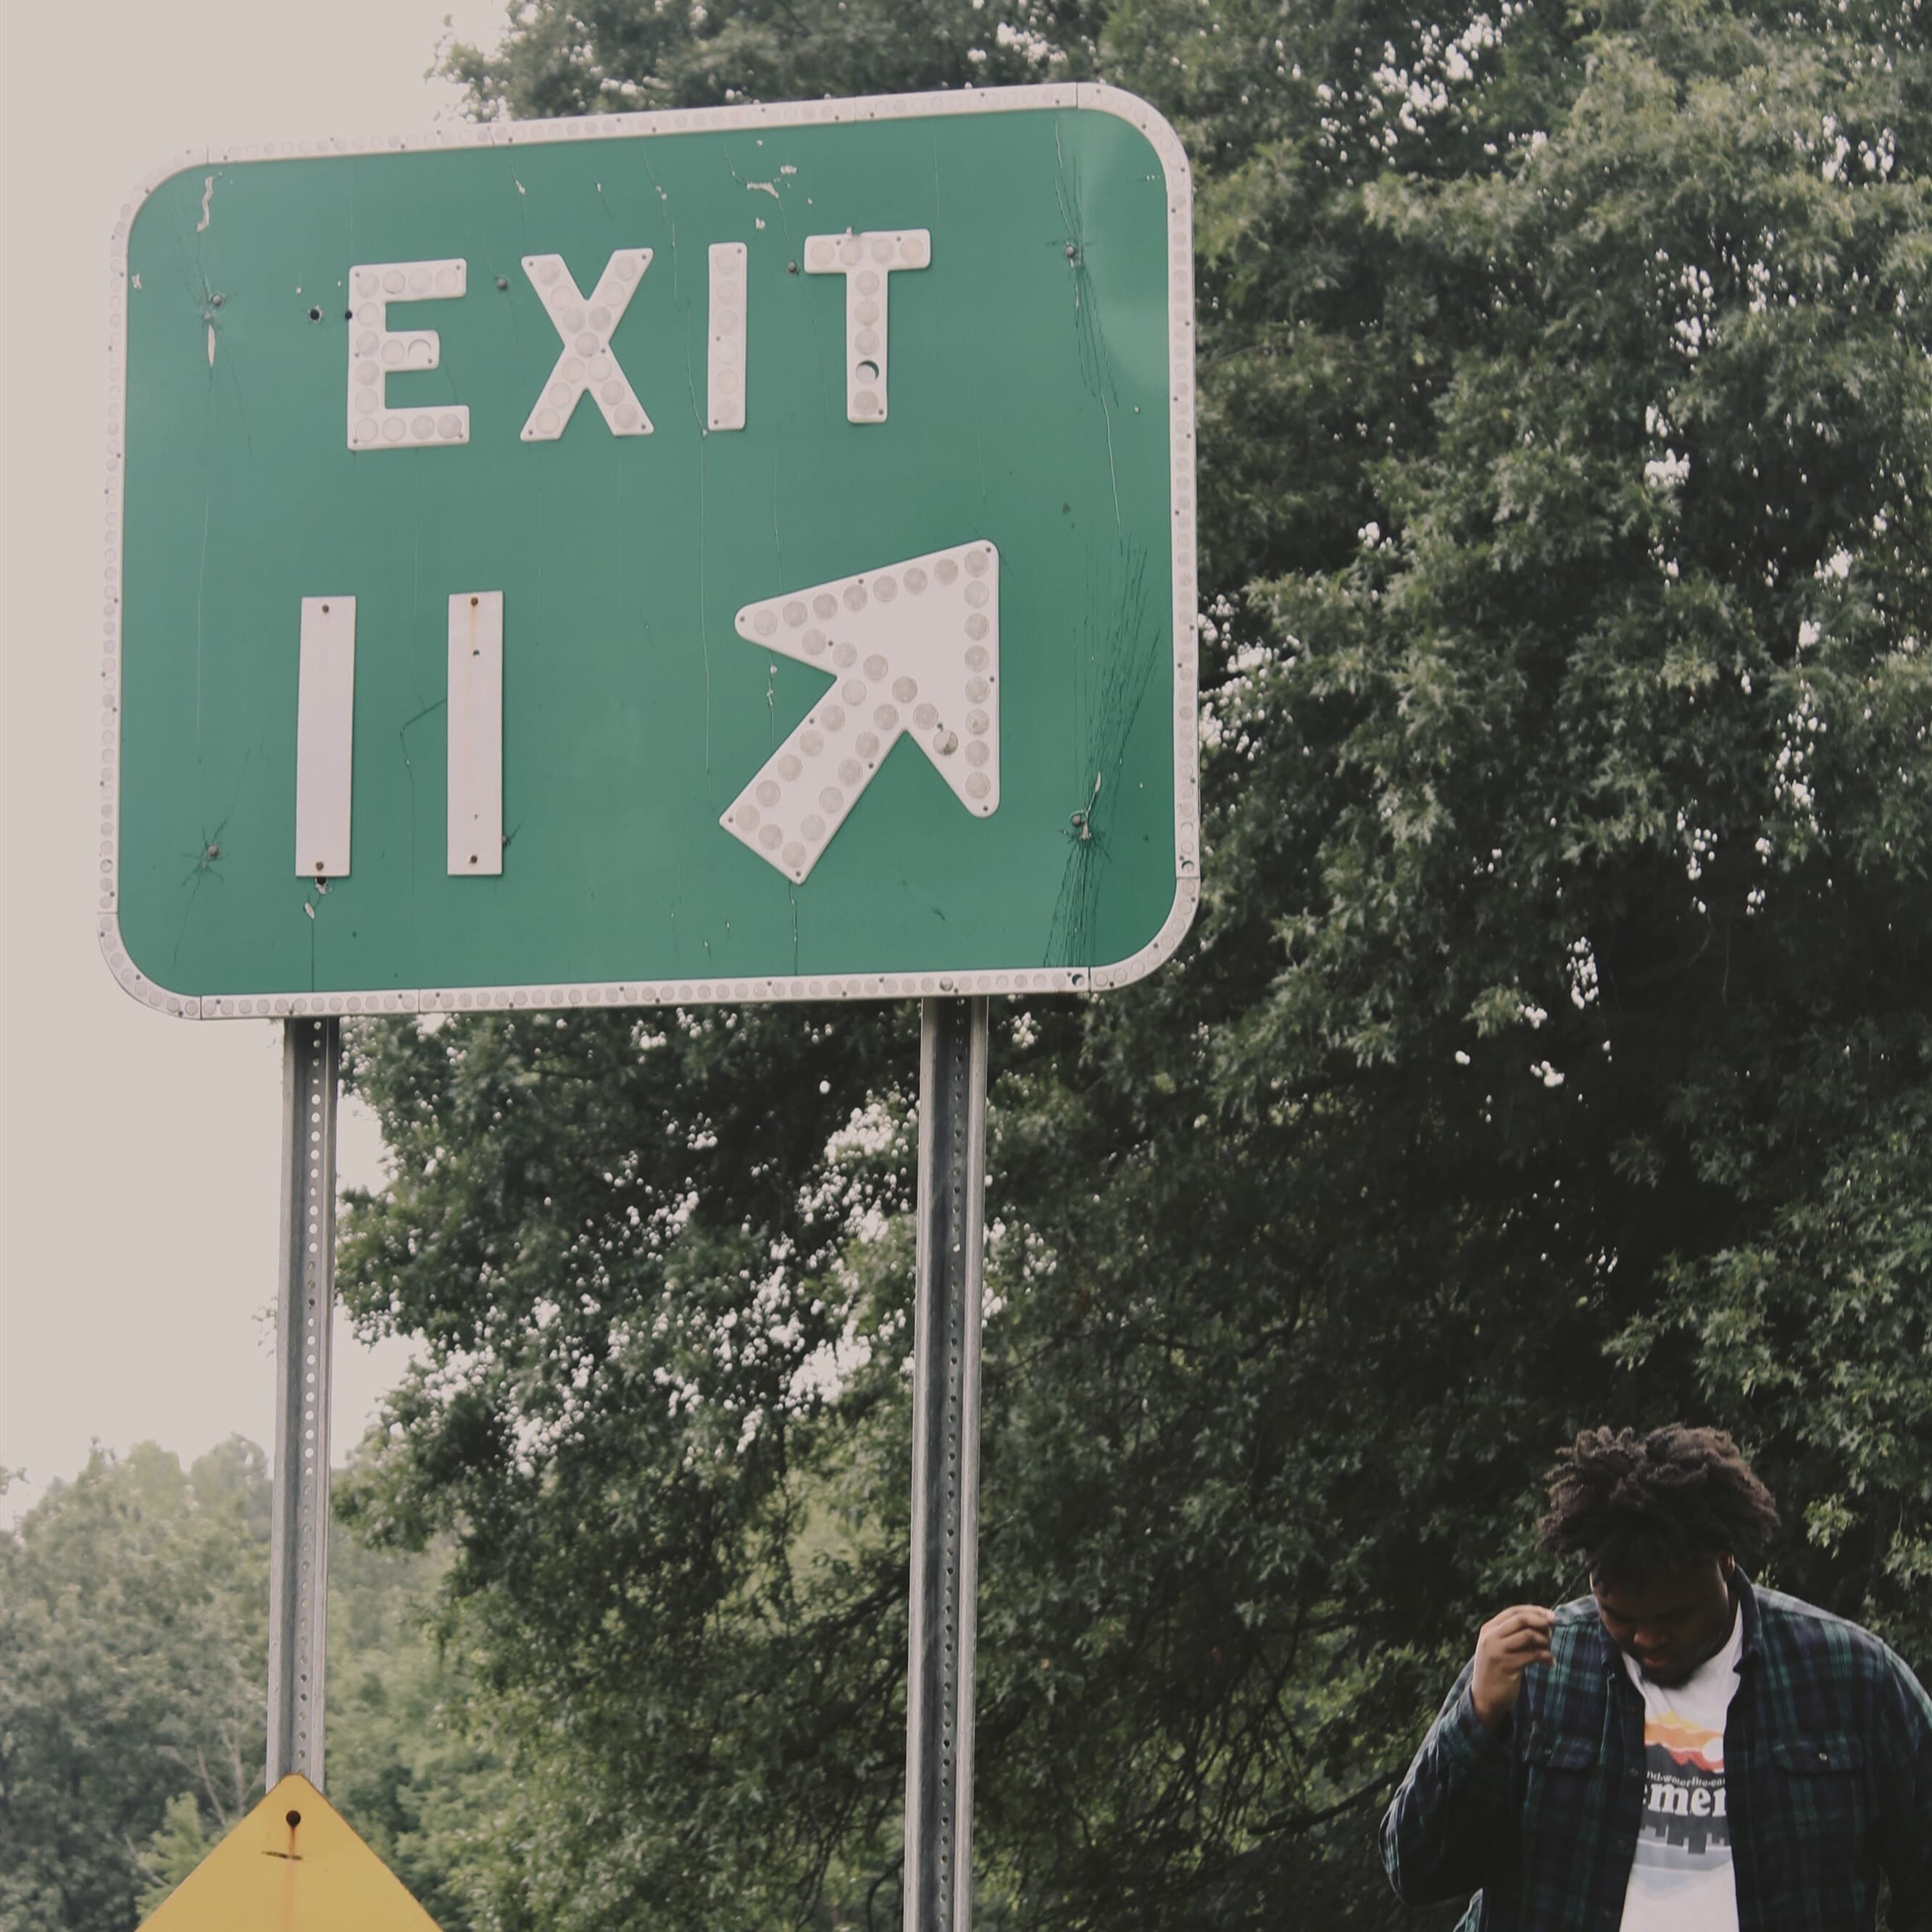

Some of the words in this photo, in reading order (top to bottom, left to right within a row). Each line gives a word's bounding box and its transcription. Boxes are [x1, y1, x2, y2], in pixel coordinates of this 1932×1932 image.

[347, 228, 932, 451] EXIT
[296, 591, 504, 878] 11
[1642, 1783, 1727, 1818] me
